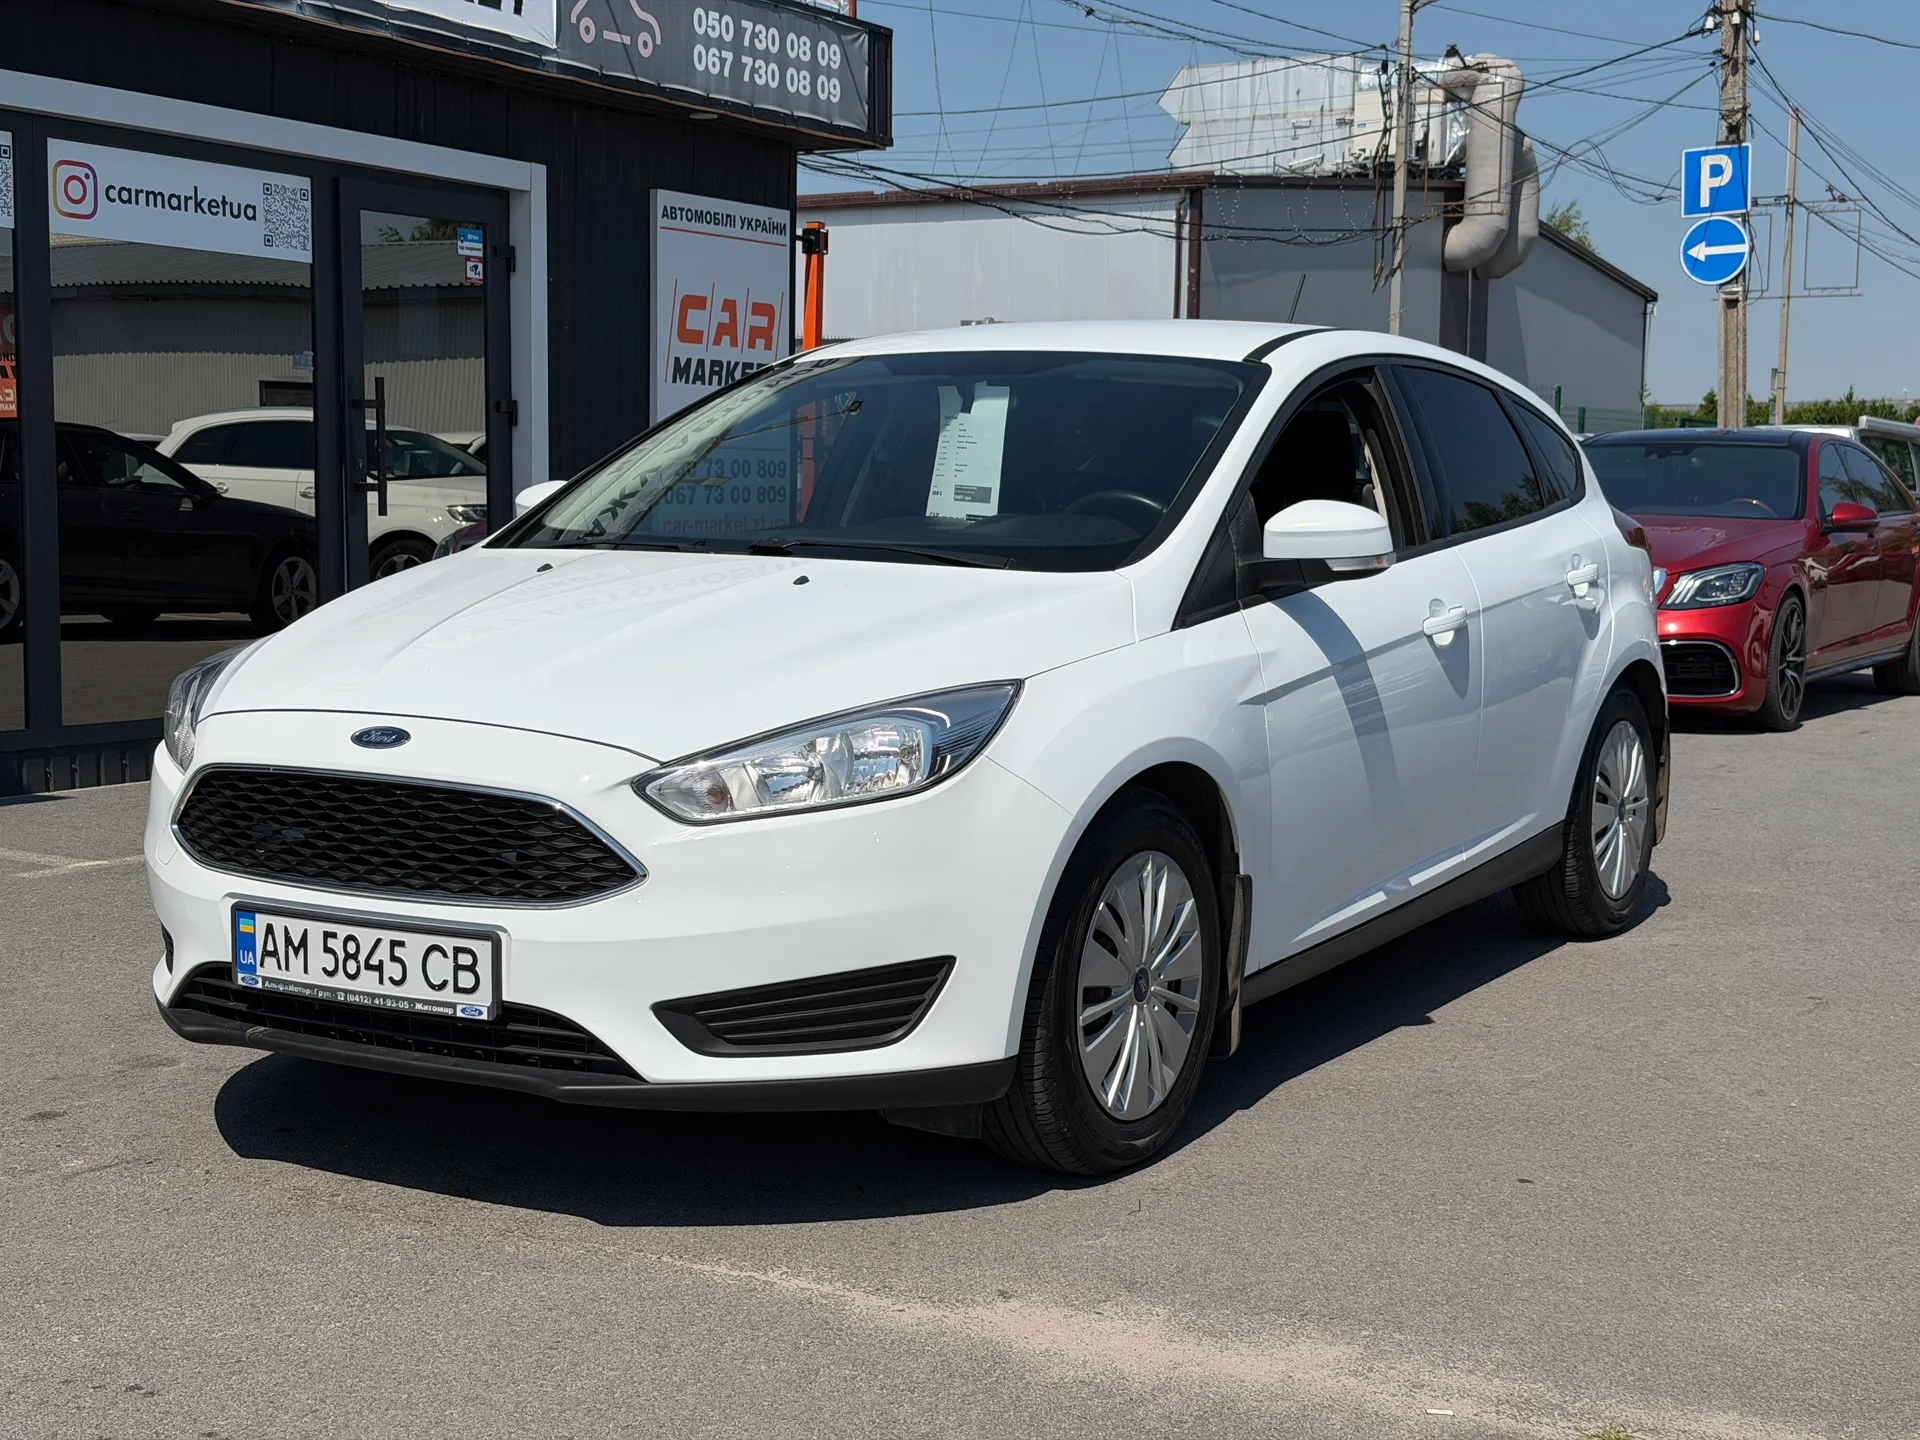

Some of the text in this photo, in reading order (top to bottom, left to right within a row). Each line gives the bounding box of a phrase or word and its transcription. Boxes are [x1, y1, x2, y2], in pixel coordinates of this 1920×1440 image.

[693, 7, 841, 70] 050 730 08 09
[693, 44, 841, 103] 067 730 08 09
[1700, 154, 1733, 208] P
[105, 184, 257, 222] carmarketua
[661, 204, 787, 237] АВТОМОБІЛІ УКРАЇНИ
[676, 293, 776, 351] CAR
[704, 458, 725, 478] 73
[730, 458, 752, 478] 00
[757, 458, 787, 479] 809
[730, 485, 752, 505] 00
[757, 485, 787, 505] 809
[239, 950, 255, 966] UA
[259, 922, 481, 995] AM 5845 CB
[346, 992, 372, 1005] (0412)
[374, 997, 409, 1009] 41-93-05
[415, 1002, 454, 1015] Житомир
